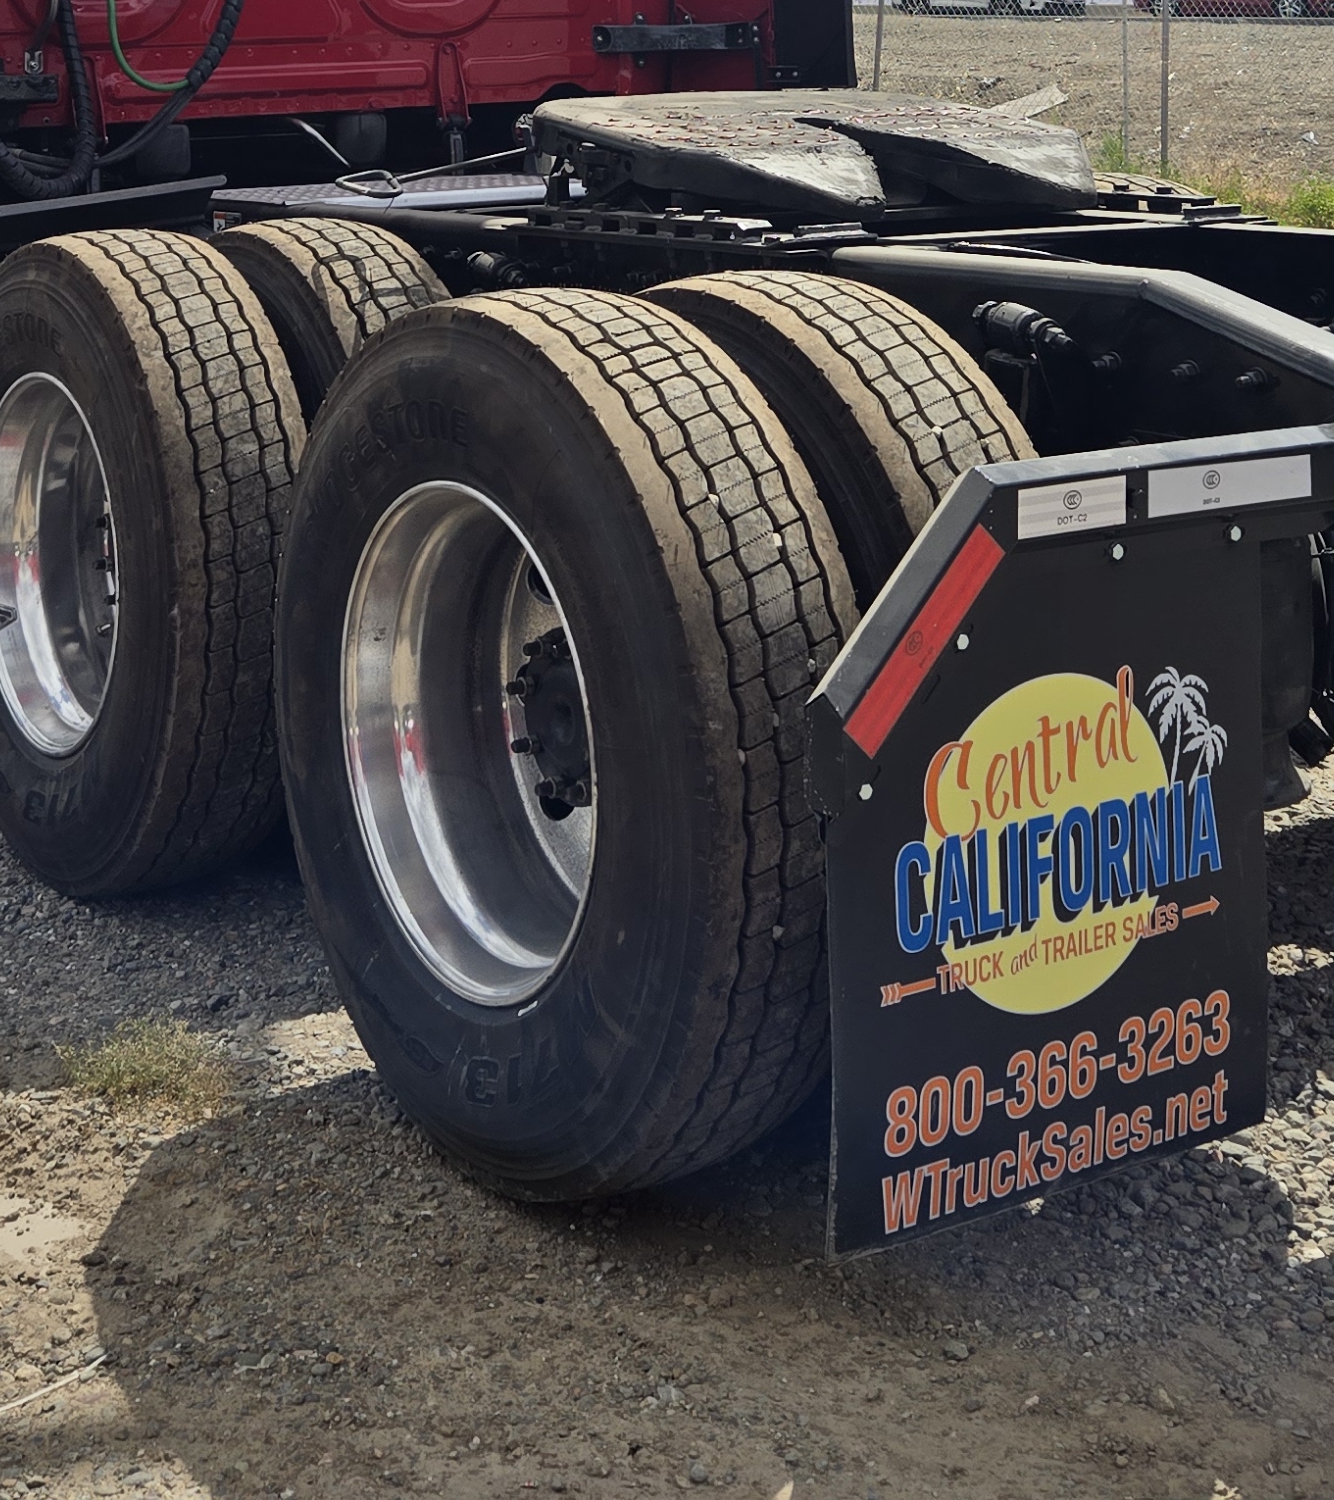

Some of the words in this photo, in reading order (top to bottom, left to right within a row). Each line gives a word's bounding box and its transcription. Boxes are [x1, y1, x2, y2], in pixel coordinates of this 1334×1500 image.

[1057, 513, 1087, 526] DOT-C2
[924, 665, 1138, 841] Central
[895, 774, 1222, 953] CALIFORNIA
[937, 951, 1004, 994] TRUCK
[1010, 933, 1038, 975] and
[1041, 921, 1117, 965] TRAILER
[1122, 902, 1179, 940] SALES
[882, 1069, 1229, 1235] WTruckSales.net
[884, 990, 1231, 1158] 800-366-3263
